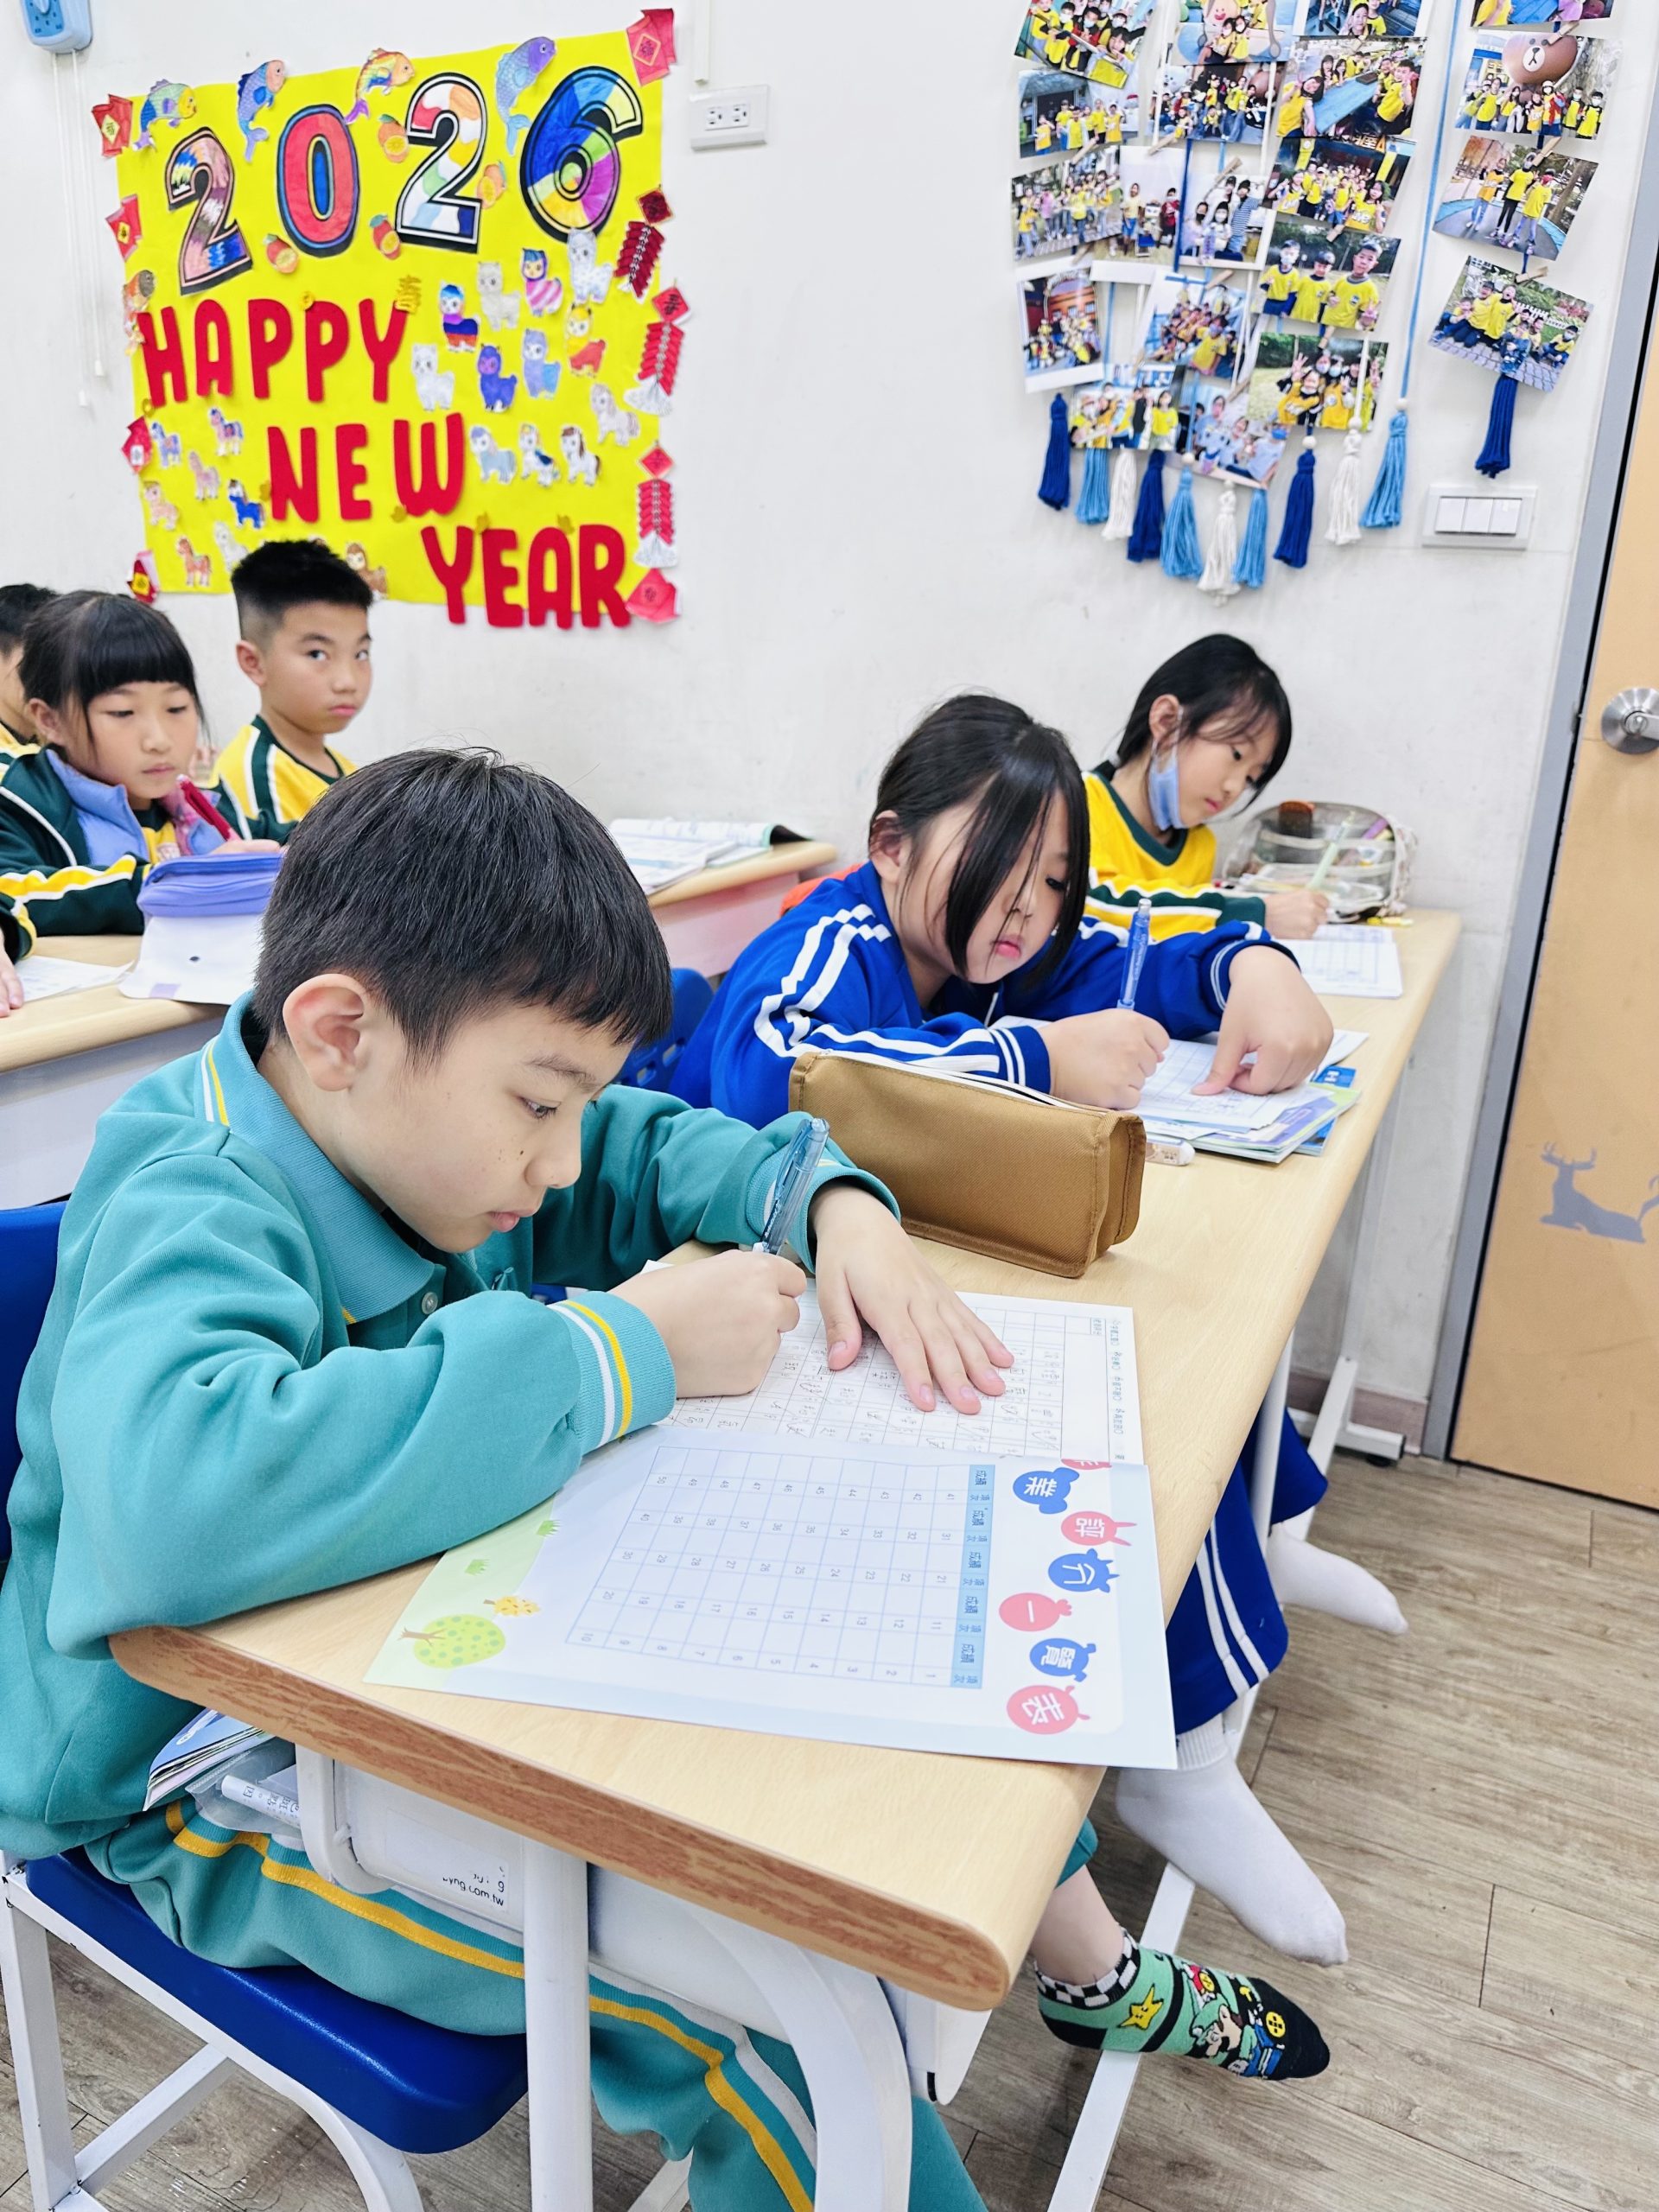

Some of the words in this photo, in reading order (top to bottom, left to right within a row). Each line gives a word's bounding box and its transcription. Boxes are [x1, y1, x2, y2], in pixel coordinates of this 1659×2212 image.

[168, 66, 643, 295] 2026
[137, 299, 409, 408] HAPPY
[267, 414, 465, 523] NEW
[421, 524, 632, 629] YEAR
[656, 1476, 668, 1484] 50
[974, 1469, 988, 1486] 成績
[719, 1479, 729, 1489] 48
[753, 1482, 761, 1491] 47
[783, 1484, 793, 1492] 46
[815, 1485, 825, 1495] 45
[848, 1488, 858, 1497] 44
[880, 1491, 890, 1500] 43
[912, 1492, 922, 1501] 42
[639, 1513, 651, 1522] 40
[672, 1516, 684, 1524] 39
[705, 1517, 717, 1527] 38
[972, 1510, 985, 1527] 成績
[739, 1520, 750, 1529] 37
[772, 1522, 784, 1532] 36
[804, 1524, 817, 1535] 35
[839, 1528, 850, 1536] 34
[873, 1529, 883, 1539] 33
[906, 1531, 918, 1541] 32
[941, 1532, 951, 1541] 31
[621, 1551, 634, 1560] 30
[656, 1554, 668, 1564] 29
[969, 1551, 982, 1570] 成績
[690, 1557, 702, 1567] 28
[725, 1560, 737, 1570] 27
[760, 1562, 772, 1573] 26
[794, 1566, 806, 1575] 25
[830, 1568, 842, 1578] 24
[864, 1570, 876, 1580] 23
[899, 1573, 912, 1583] 22
[937, 1575, 948, 1584] 21
[601, 1591, 615, 1600] 20
[638, 1596, 651, 1605] 19
[673, 1600, 686, 1610] 18
[710, 1604, 722, 1613] 17
[965, 1595, 978, 1614] 成績
[746, 1607, 759, 1617] 16
[782, 1611, 795, 1620] 15
[820, 1613, 830, 1623] 14
[856, 1617, 868, 1626] 13
[893, 1618, 905, 1629] 12
[931, 1621, 943, 1630] 11
[580, 1632, 594, 1643] 10
[960, 1643, 976, 1664] 成績
